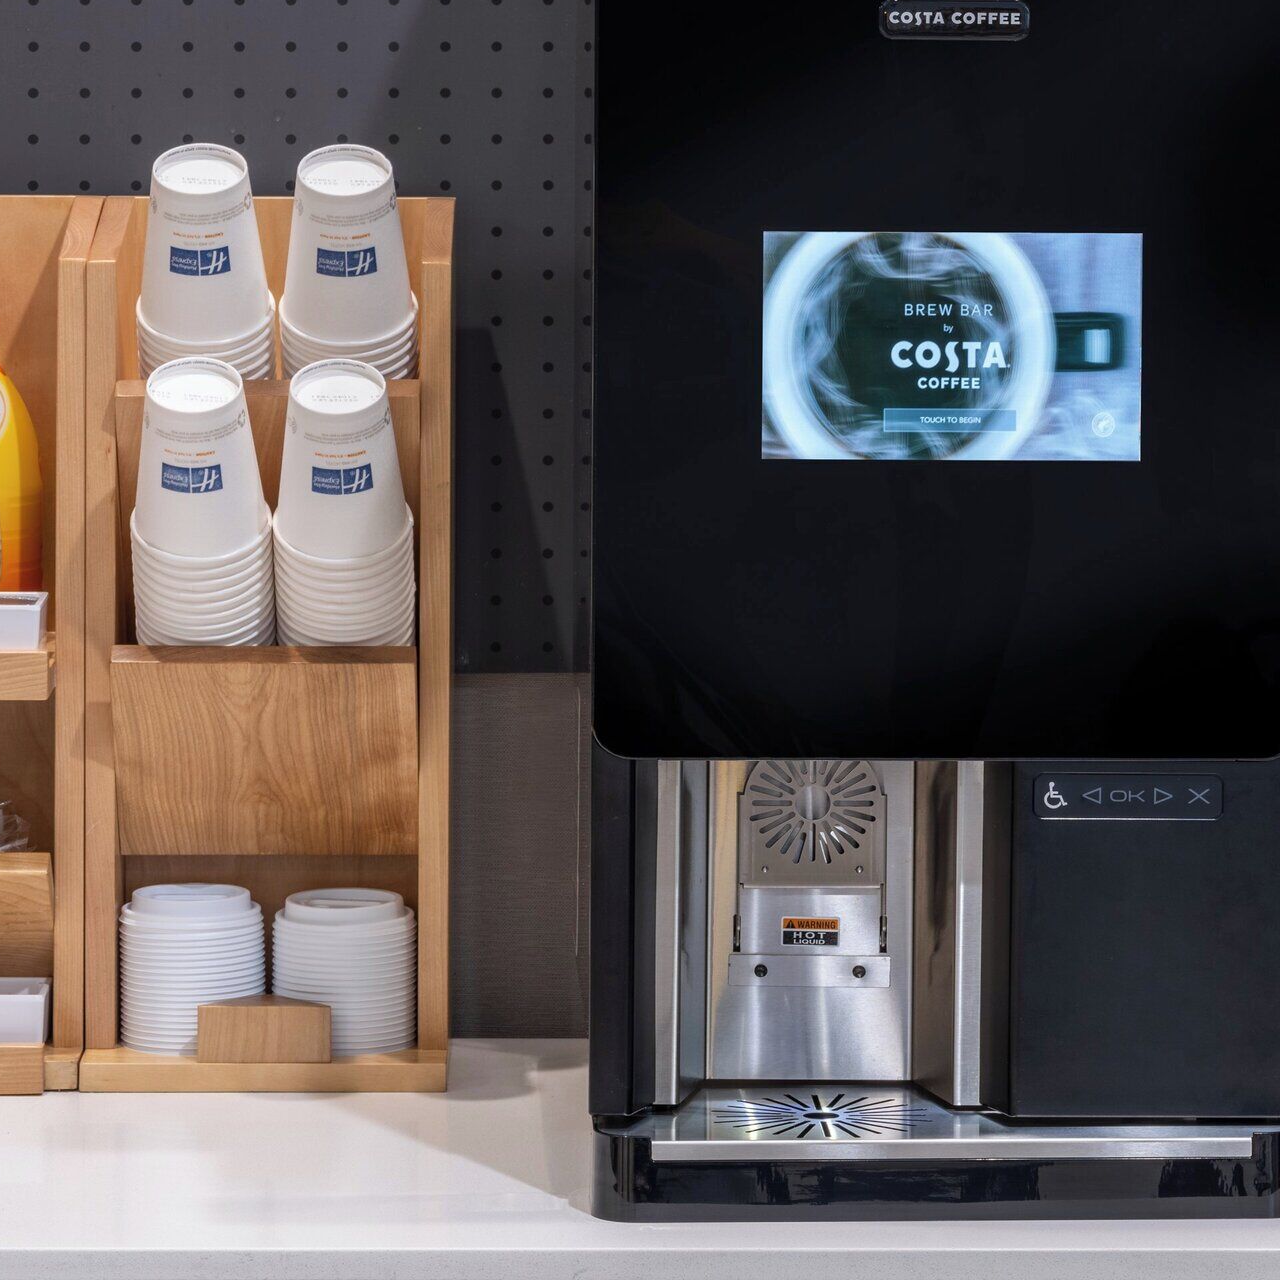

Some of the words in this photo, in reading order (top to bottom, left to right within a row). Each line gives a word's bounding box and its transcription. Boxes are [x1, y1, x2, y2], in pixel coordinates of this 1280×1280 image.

[889, 12, 945, 25] COSTA
[951, 12, 1020, 25] COFFEE
[171, 256, 197, 265] Express
[318, 258, 344, 267] Express
[904, 304, 953, 316] BREW
[961, 304, 993, 316] BAR
[943, 324, 953, 333] by
[891, 340, 1007, 373] COSTA
[918, 377, 980, 389] COFFEE
[163, 473, 188, 482] Express
[313, 476, 340, 484] Express
[1110, 790, 1145, 802] OK
[798, 920, 836, 929] WARNING
